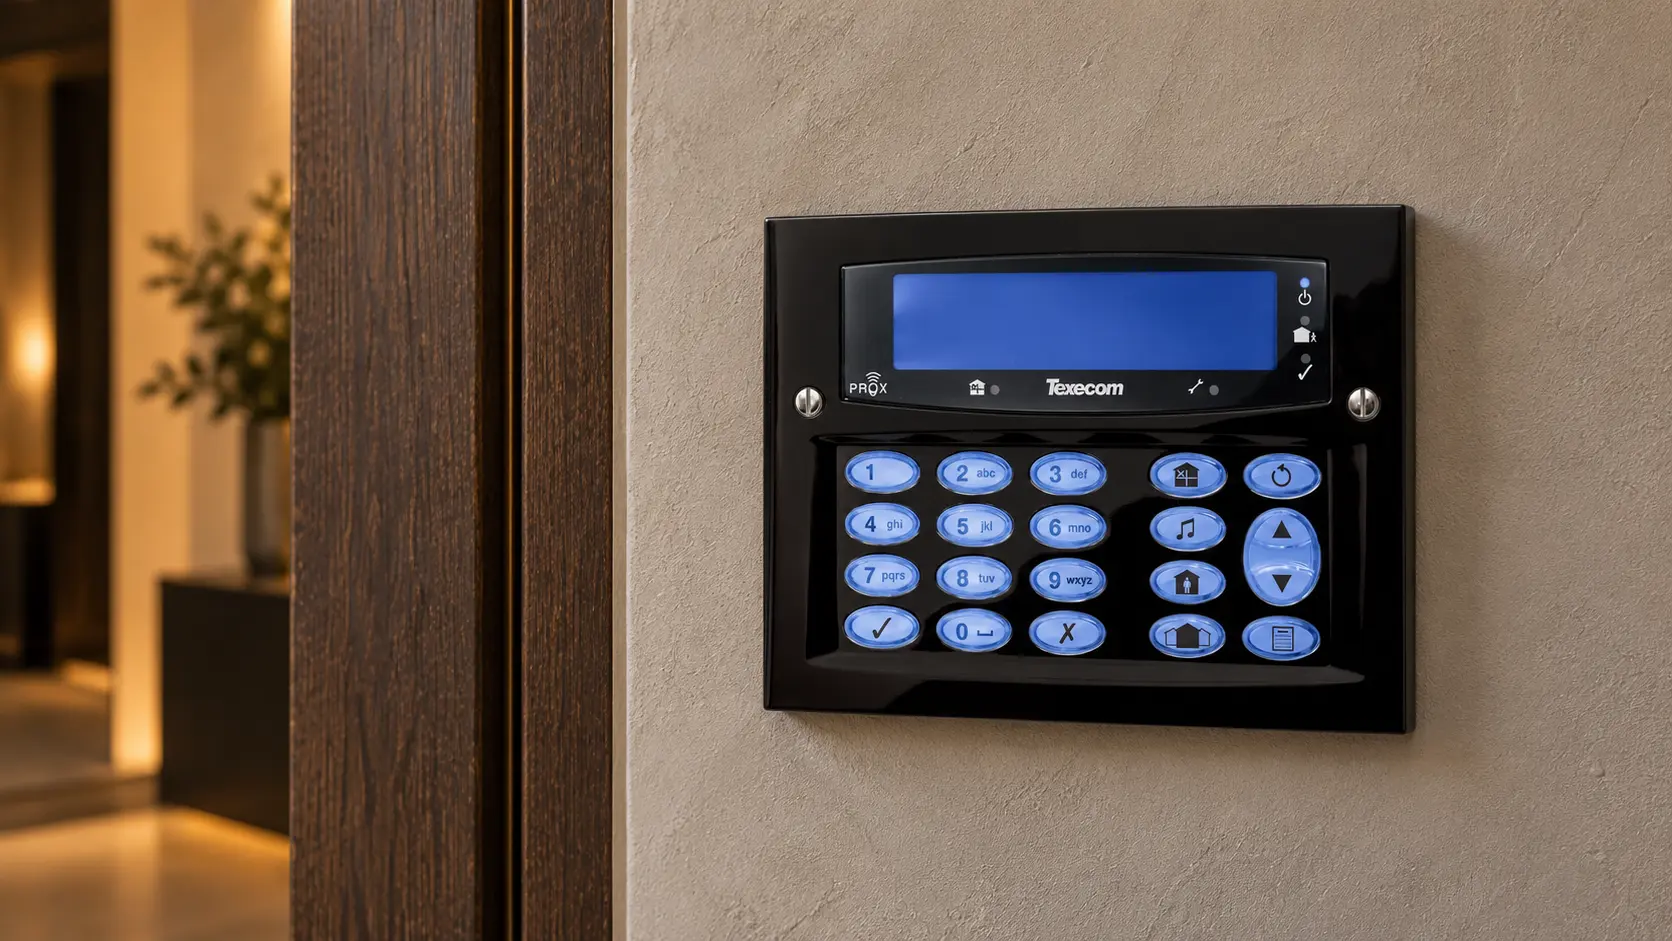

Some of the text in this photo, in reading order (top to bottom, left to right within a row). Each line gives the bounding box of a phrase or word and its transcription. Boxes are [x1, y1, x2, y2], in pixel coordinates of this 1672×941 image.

[849, 382, 888, 396] PROX
[1046, 378, 1124, 396] Texecom
[865, 463, 874, 481] 1
[956, 464, 996, 482] 2 abc
[1049, 465, 1088, 483] 3 def
[864, 515, 904, 532] 4 ghi
[957, 517, 993, 535] 5 jkl
[1049, 518, 1091, 536] 6 mno
[864, 566, 906, 584] 7 pqrs
[956, 569, 996, 588] 8 tuv
[1048, 571, 1093, 589] 9 wxyz
[955, 622, 968, 641] 0
